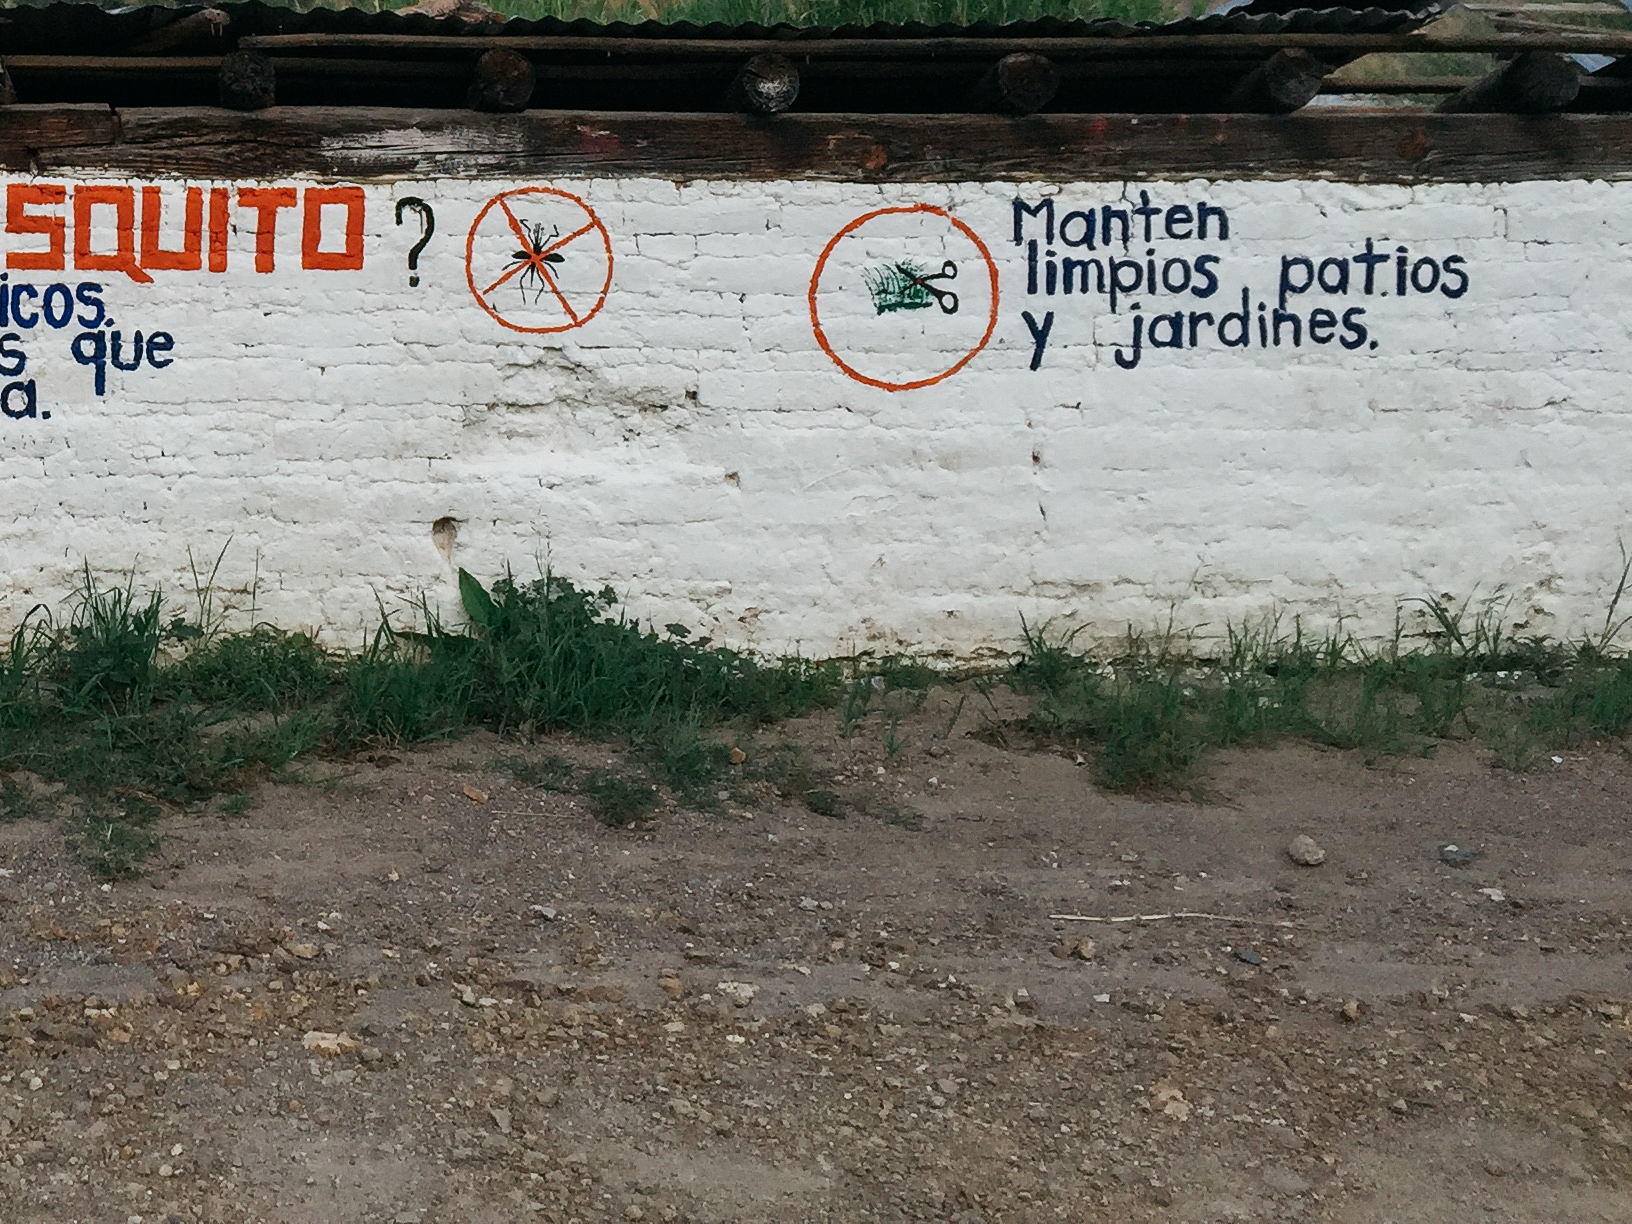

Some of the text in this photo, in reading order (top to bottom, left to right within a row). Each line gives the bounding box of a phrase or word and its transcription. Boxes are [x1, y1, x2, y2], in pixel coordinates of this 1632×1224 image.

[1012, 190, 1230, 251] Manten
[1026, 237, 1470, 312] limpios patios
[71, 329, 175, 397] que
[1021, 287, 1379, 372] y jardines.
